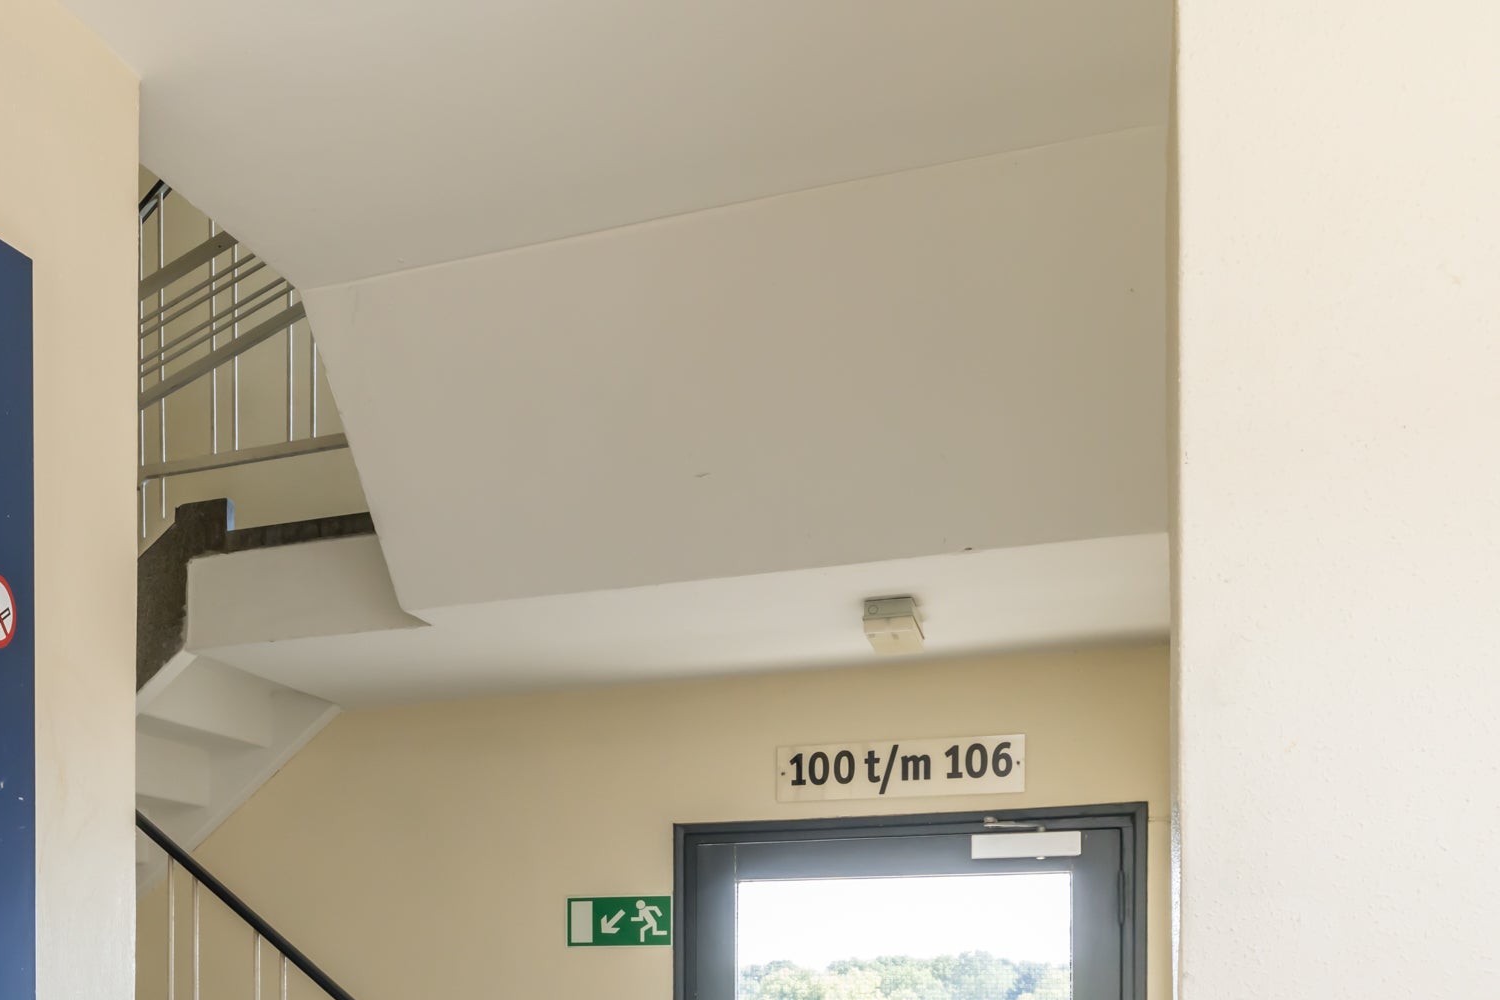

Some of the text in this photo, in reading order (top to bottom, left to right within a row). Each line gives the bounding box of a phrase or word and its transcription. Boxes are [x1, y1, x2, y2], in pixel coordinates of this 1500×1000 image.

[789, 742, 1013, 794] 100 t/m 106
